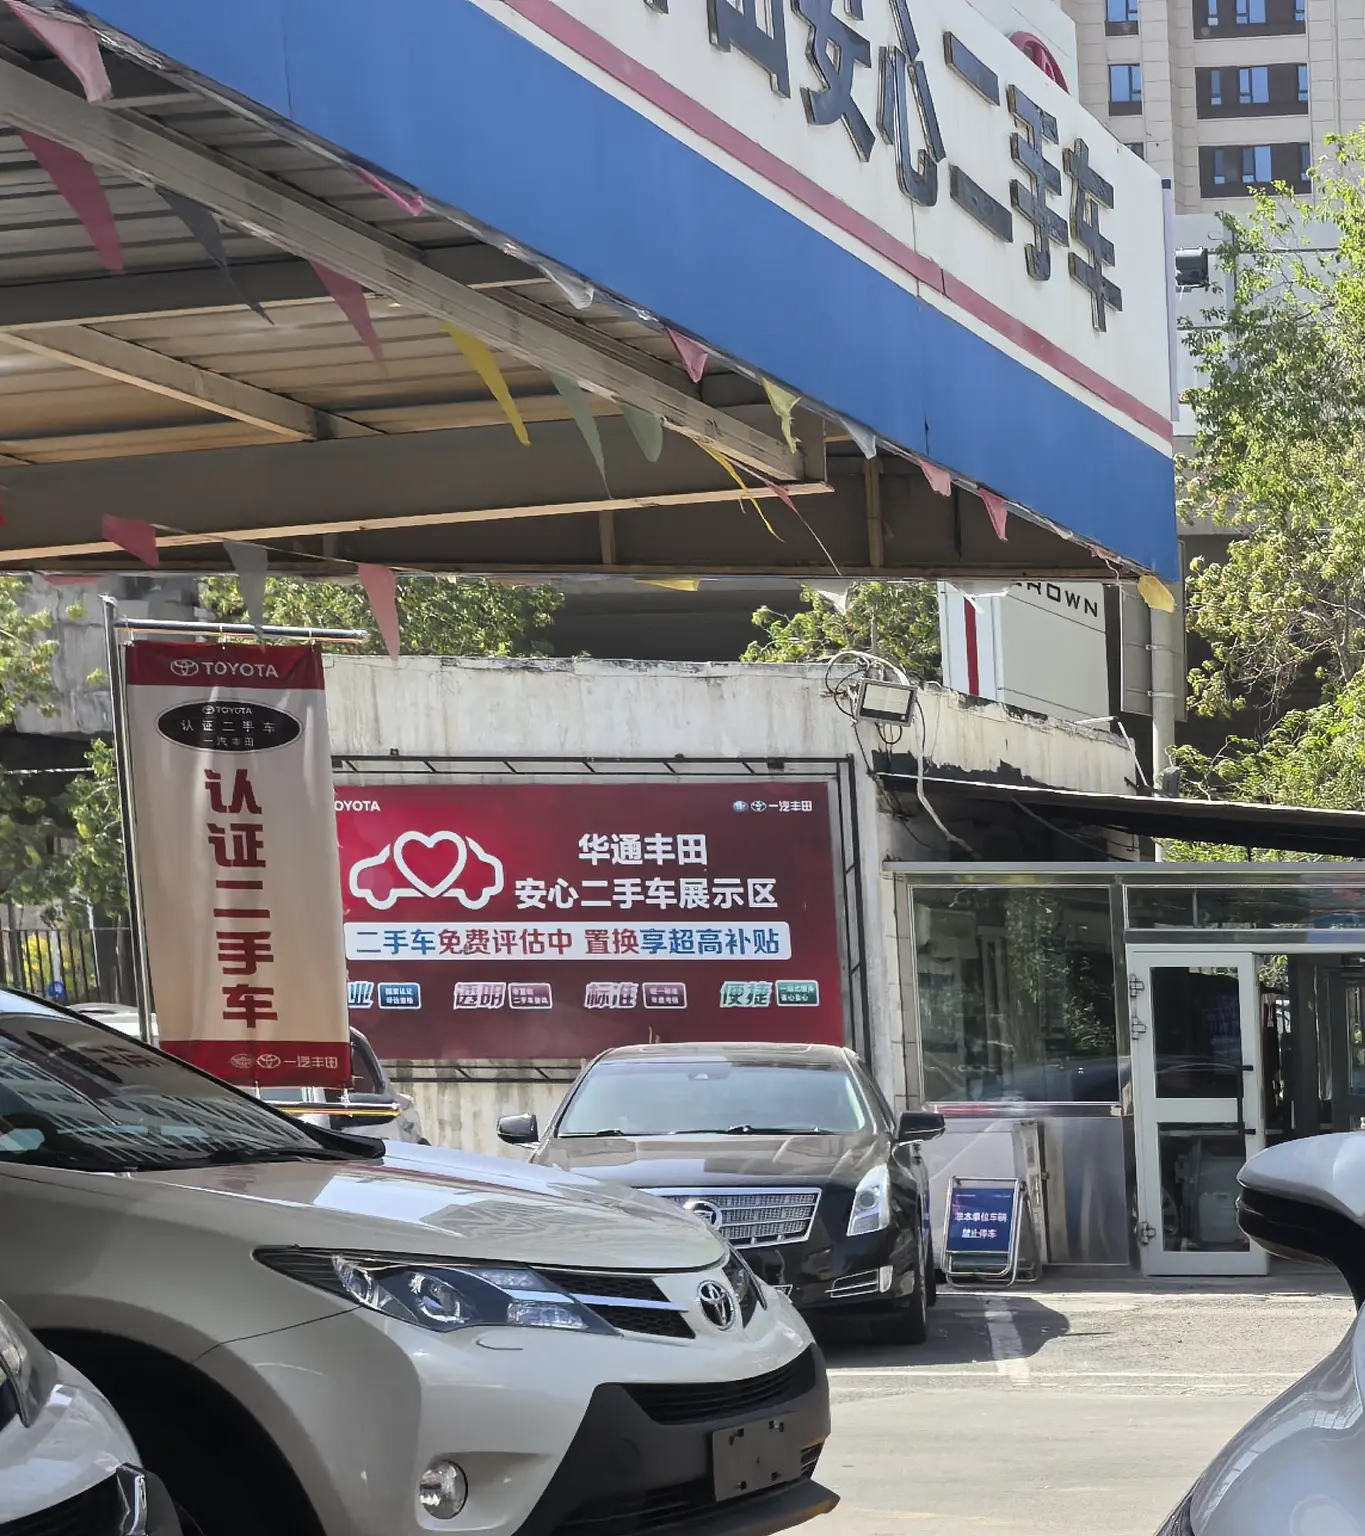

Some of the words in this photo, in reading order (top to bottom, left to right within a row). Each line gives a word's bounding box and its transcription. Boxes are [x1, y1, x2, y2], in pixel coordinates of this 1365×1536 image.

[201, 661, 279, 679] TOYOTA
[216, 706, 252, 715] TOYOTA
[181, 719, 275, 734] 认证二手车
[334, 800, 381, 812] OYOTA
[768, 800, 813, 813] 一汽丰田
[578, 833, 708, 866] 华通丰田
[204, 768, 278, 1029] 认证二手车
[514, 877, 778, 910] 安心二手车展示区
[356, 929, 573, 956] 二手车免费评估中
[584, 928, 780, 956] 置换享超高补贴
[586, 983, 638, 1009] 标准
[284, 1055, 338, 1069] 一汽丰田
